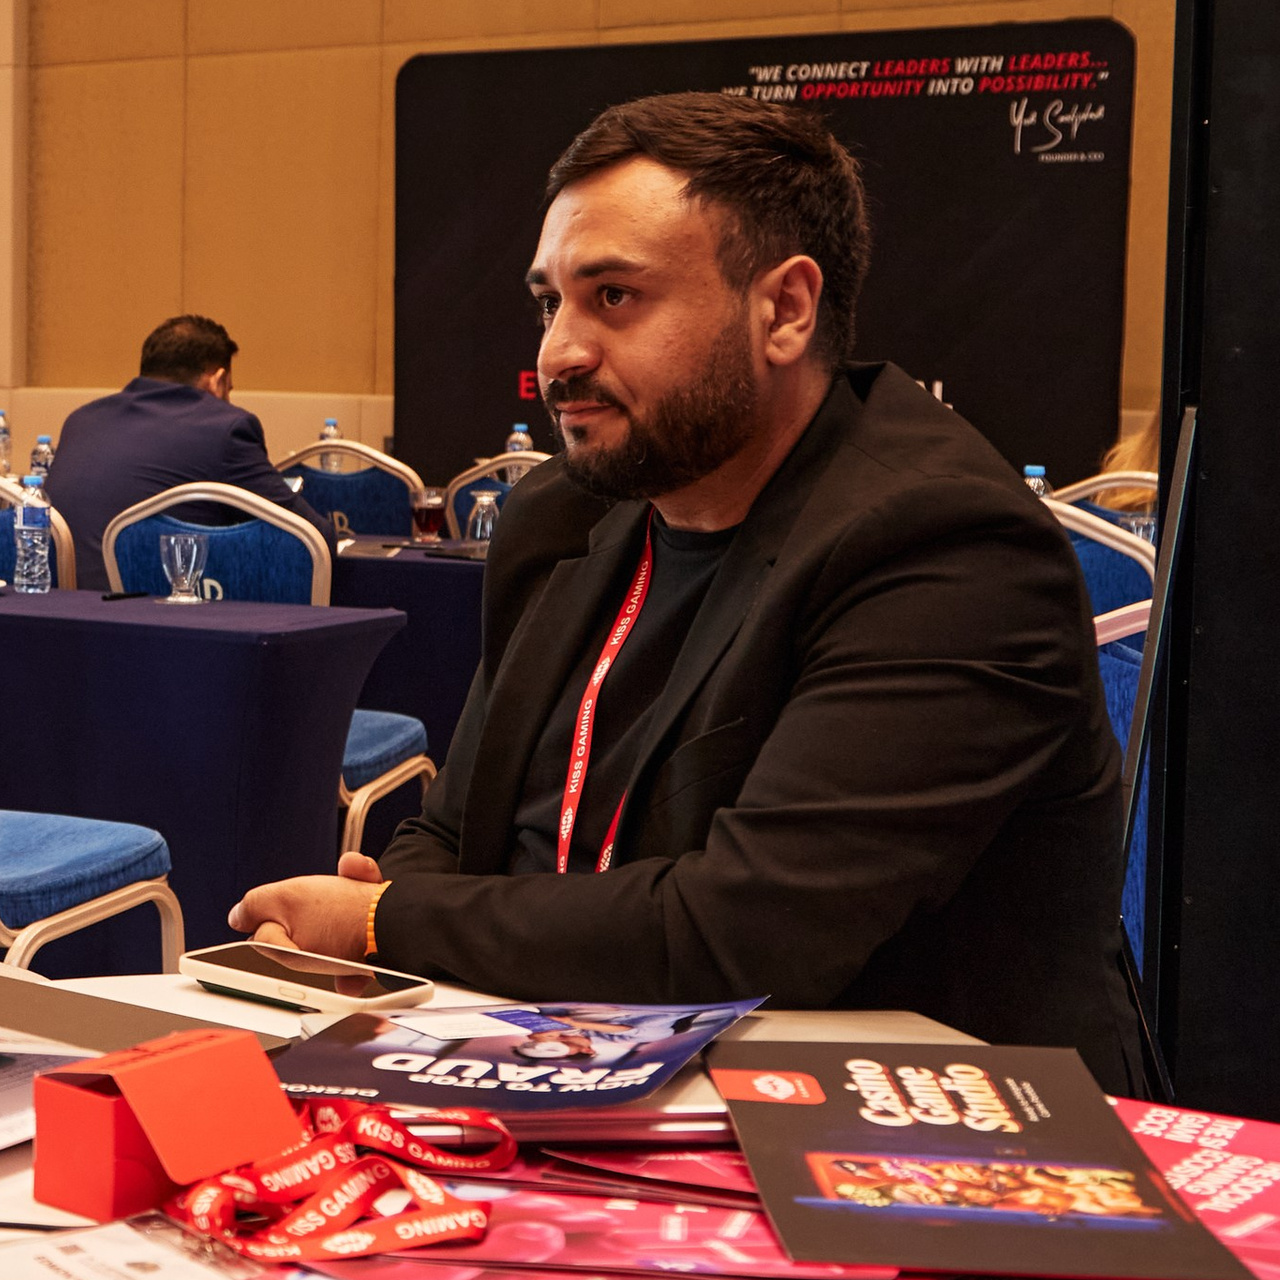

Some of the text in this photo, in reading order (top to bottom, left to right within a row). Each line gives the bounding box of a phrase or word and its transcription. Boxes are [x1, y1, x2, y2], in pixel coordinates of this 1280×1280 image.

[751, 84, 798, 101] TURN
[801, 80, 925, 100] OPPORTUNITY
[927, 77, 974, 95] INTO
[785, 61, 870, 80] CONNECT
[873, 58, 951, 78] LEADERS
[954, 55, 1004, 74] WITH
[611, 560, 649, 646] KISS GAMING
[569, 698, 593, 794] KISS GAMING
[371, 1052, 665, 1086] FRAUD
[409, 1073, 652, 1093] HOW TO STOP
[844, 1058, 914, 1127] Casino
[895, 1066, 961, 1126] Game
[939, 1063, 1022, 1134] Studio
[357, 1116, 491, 1169] KISS GAMING
[260, 1149, 336, 1192] GAMING
[320, 1162, 391, 1217] GAMING
[395, 1208, 488, 1241] GAMING
